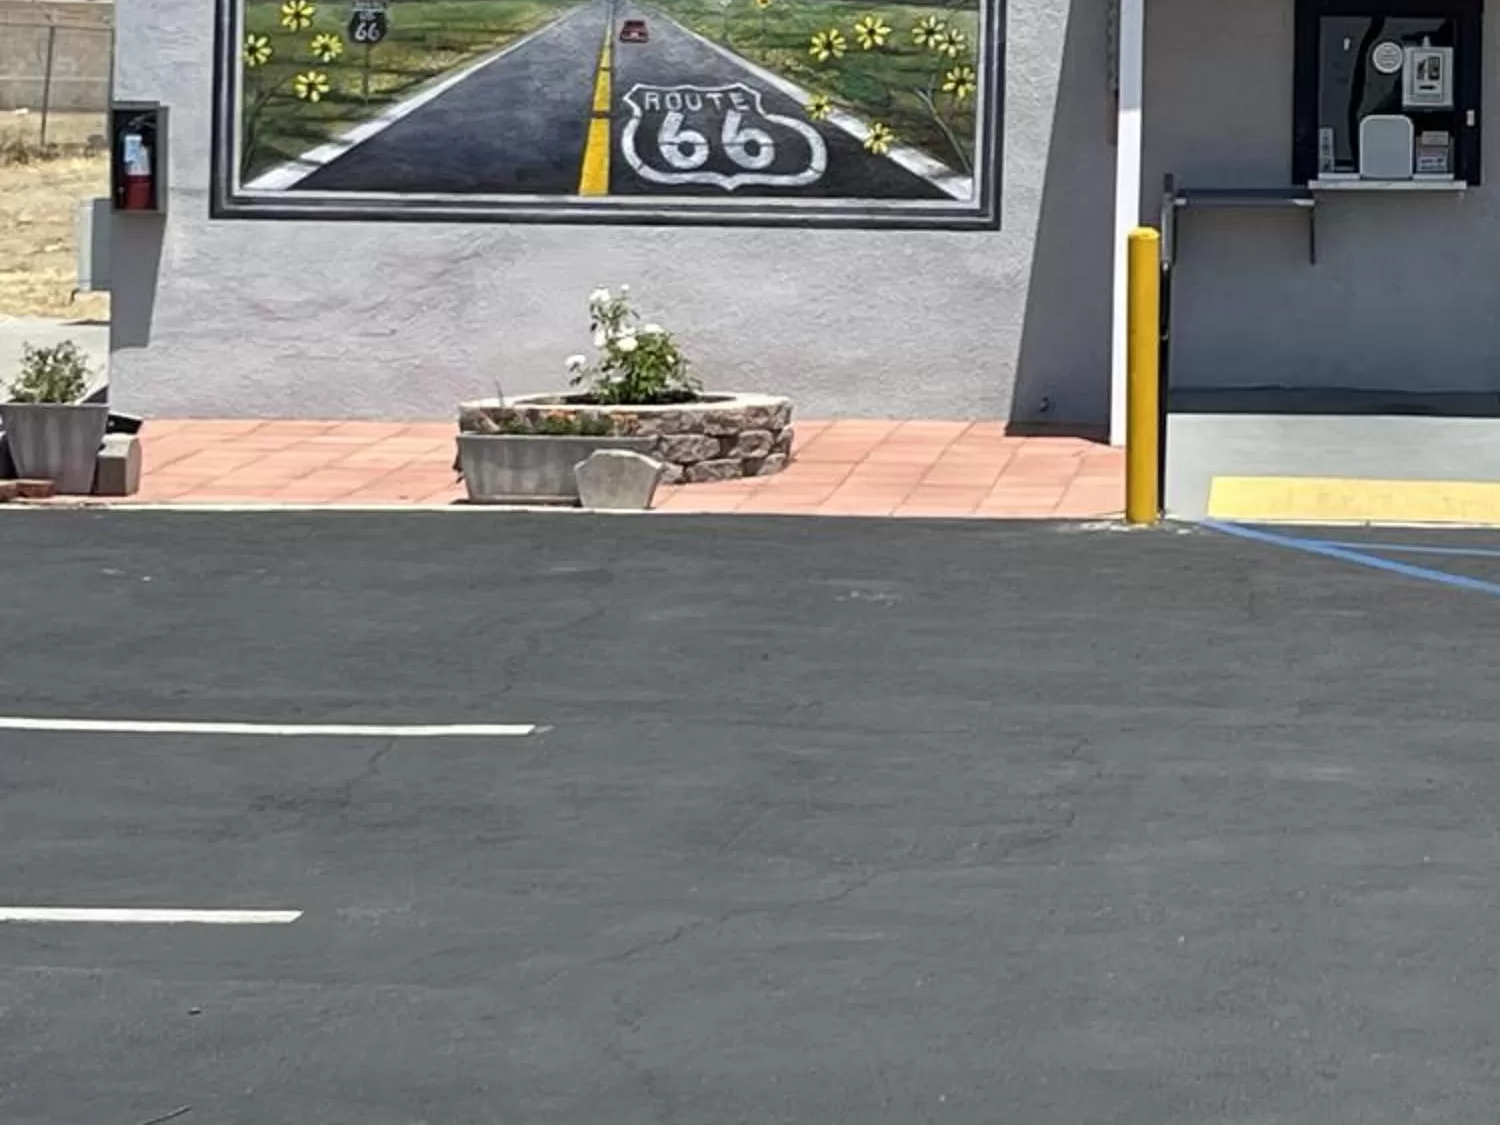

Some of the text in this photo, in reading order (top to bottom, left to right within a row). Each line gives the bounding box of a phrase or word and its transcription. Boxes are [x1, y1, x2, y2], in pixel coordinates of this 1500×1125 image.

[354, 22, 380, 41] 66
[644, 91, 750, 112] ROUTE
[657, 110, 776, 170] 66
